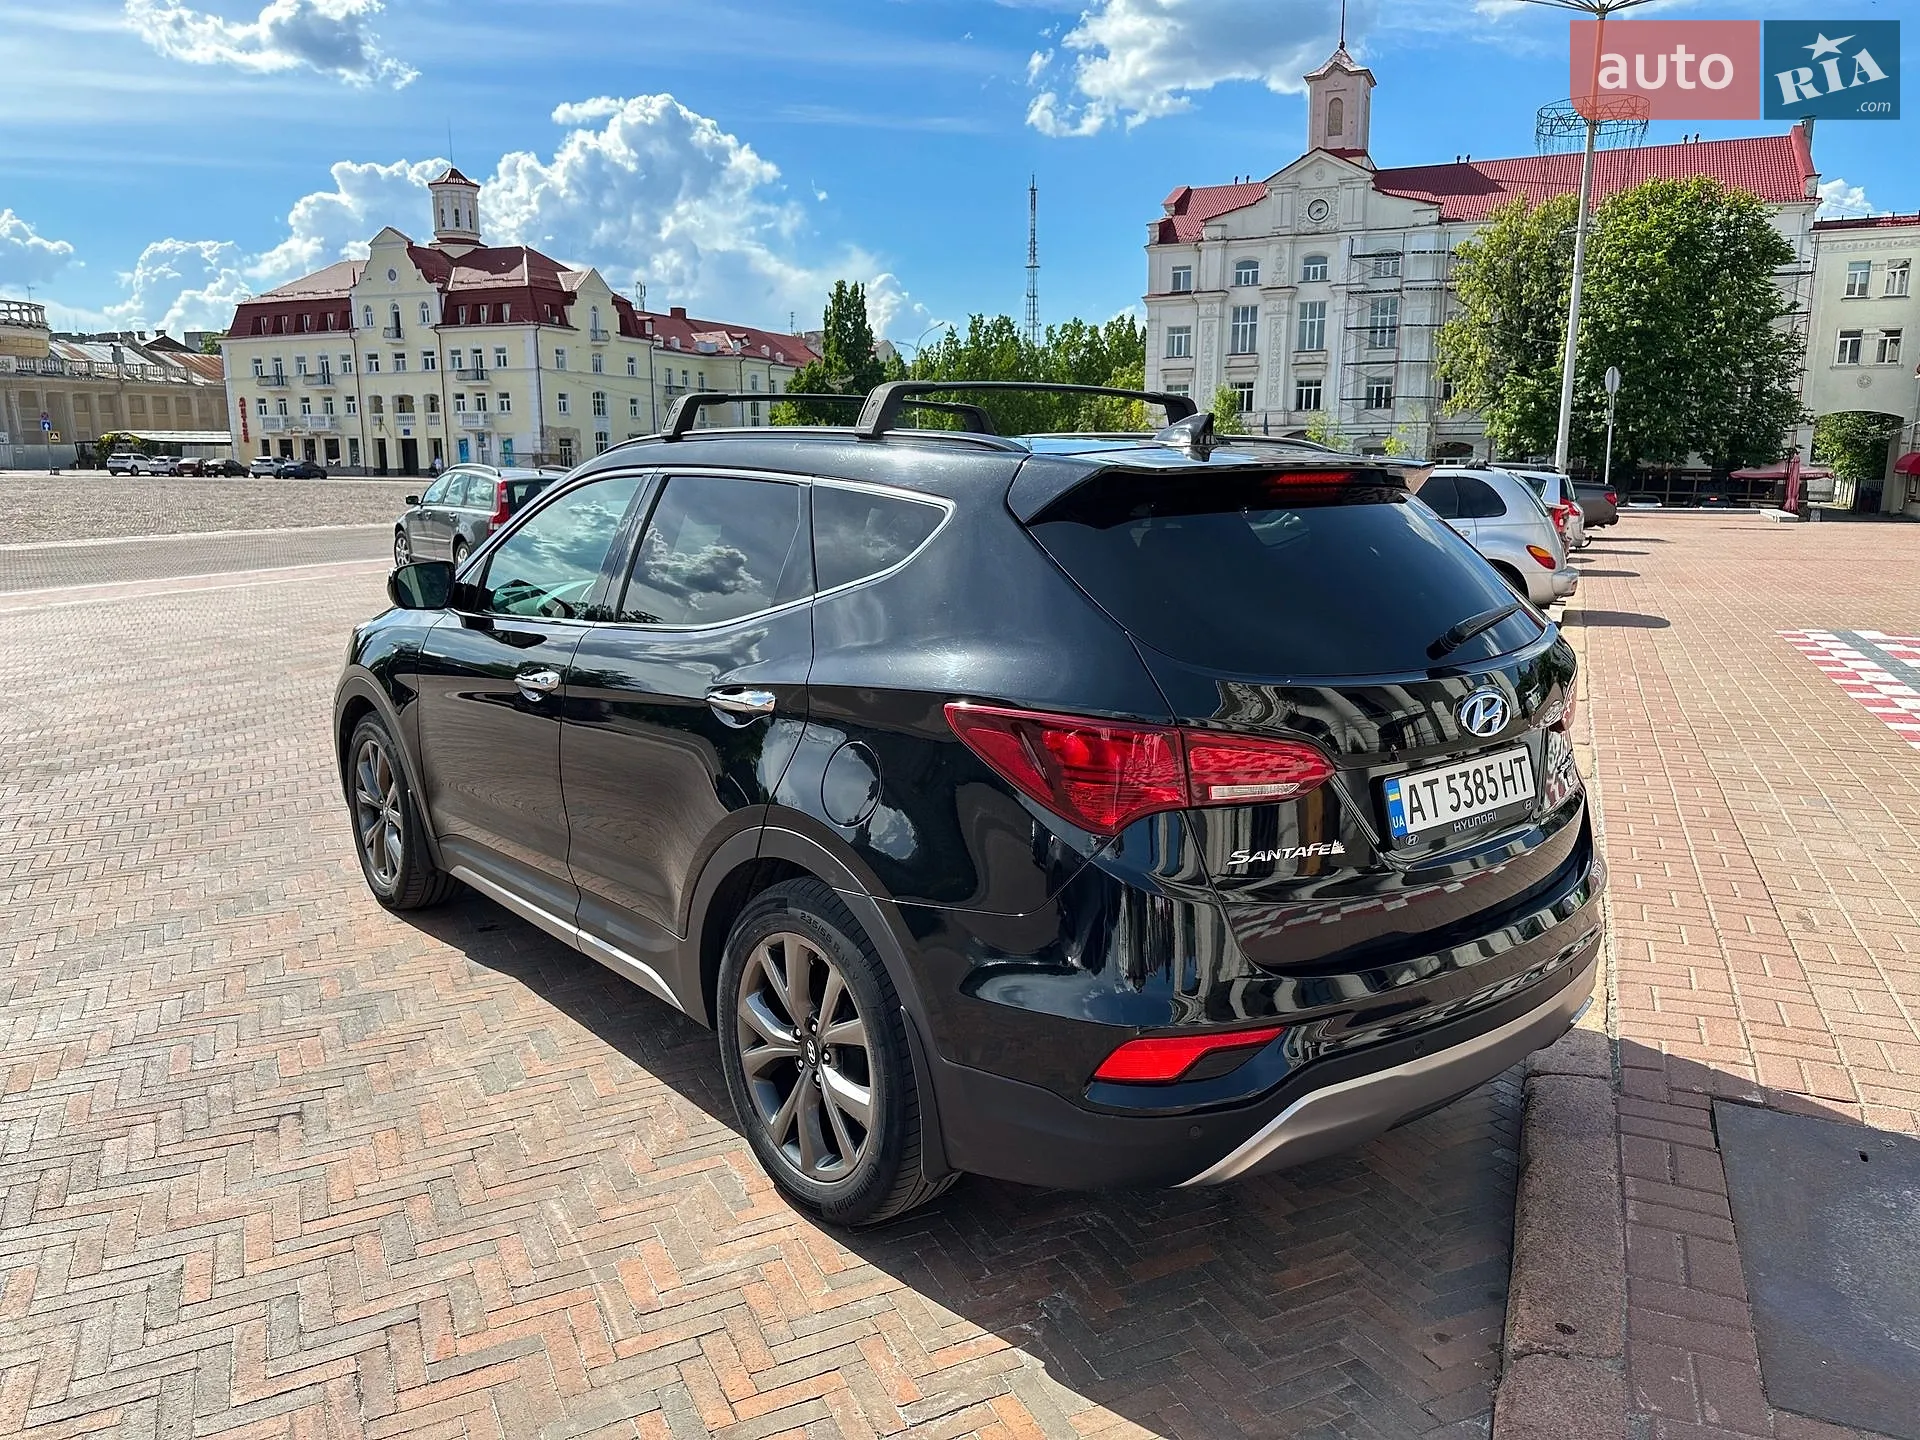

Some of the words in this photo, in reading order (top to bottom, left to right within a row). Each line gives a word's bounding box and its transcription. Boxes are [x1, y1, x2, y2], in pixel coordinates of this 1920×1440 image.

[1408, 777, 1440, 825] AT
[1445, 764, 1499, 813] 5385
[1498, 755, 1527, 799] HT
[1392, 815, 1406, 829] UA
[1452, 811, 1498, 833] HYUNDAI
